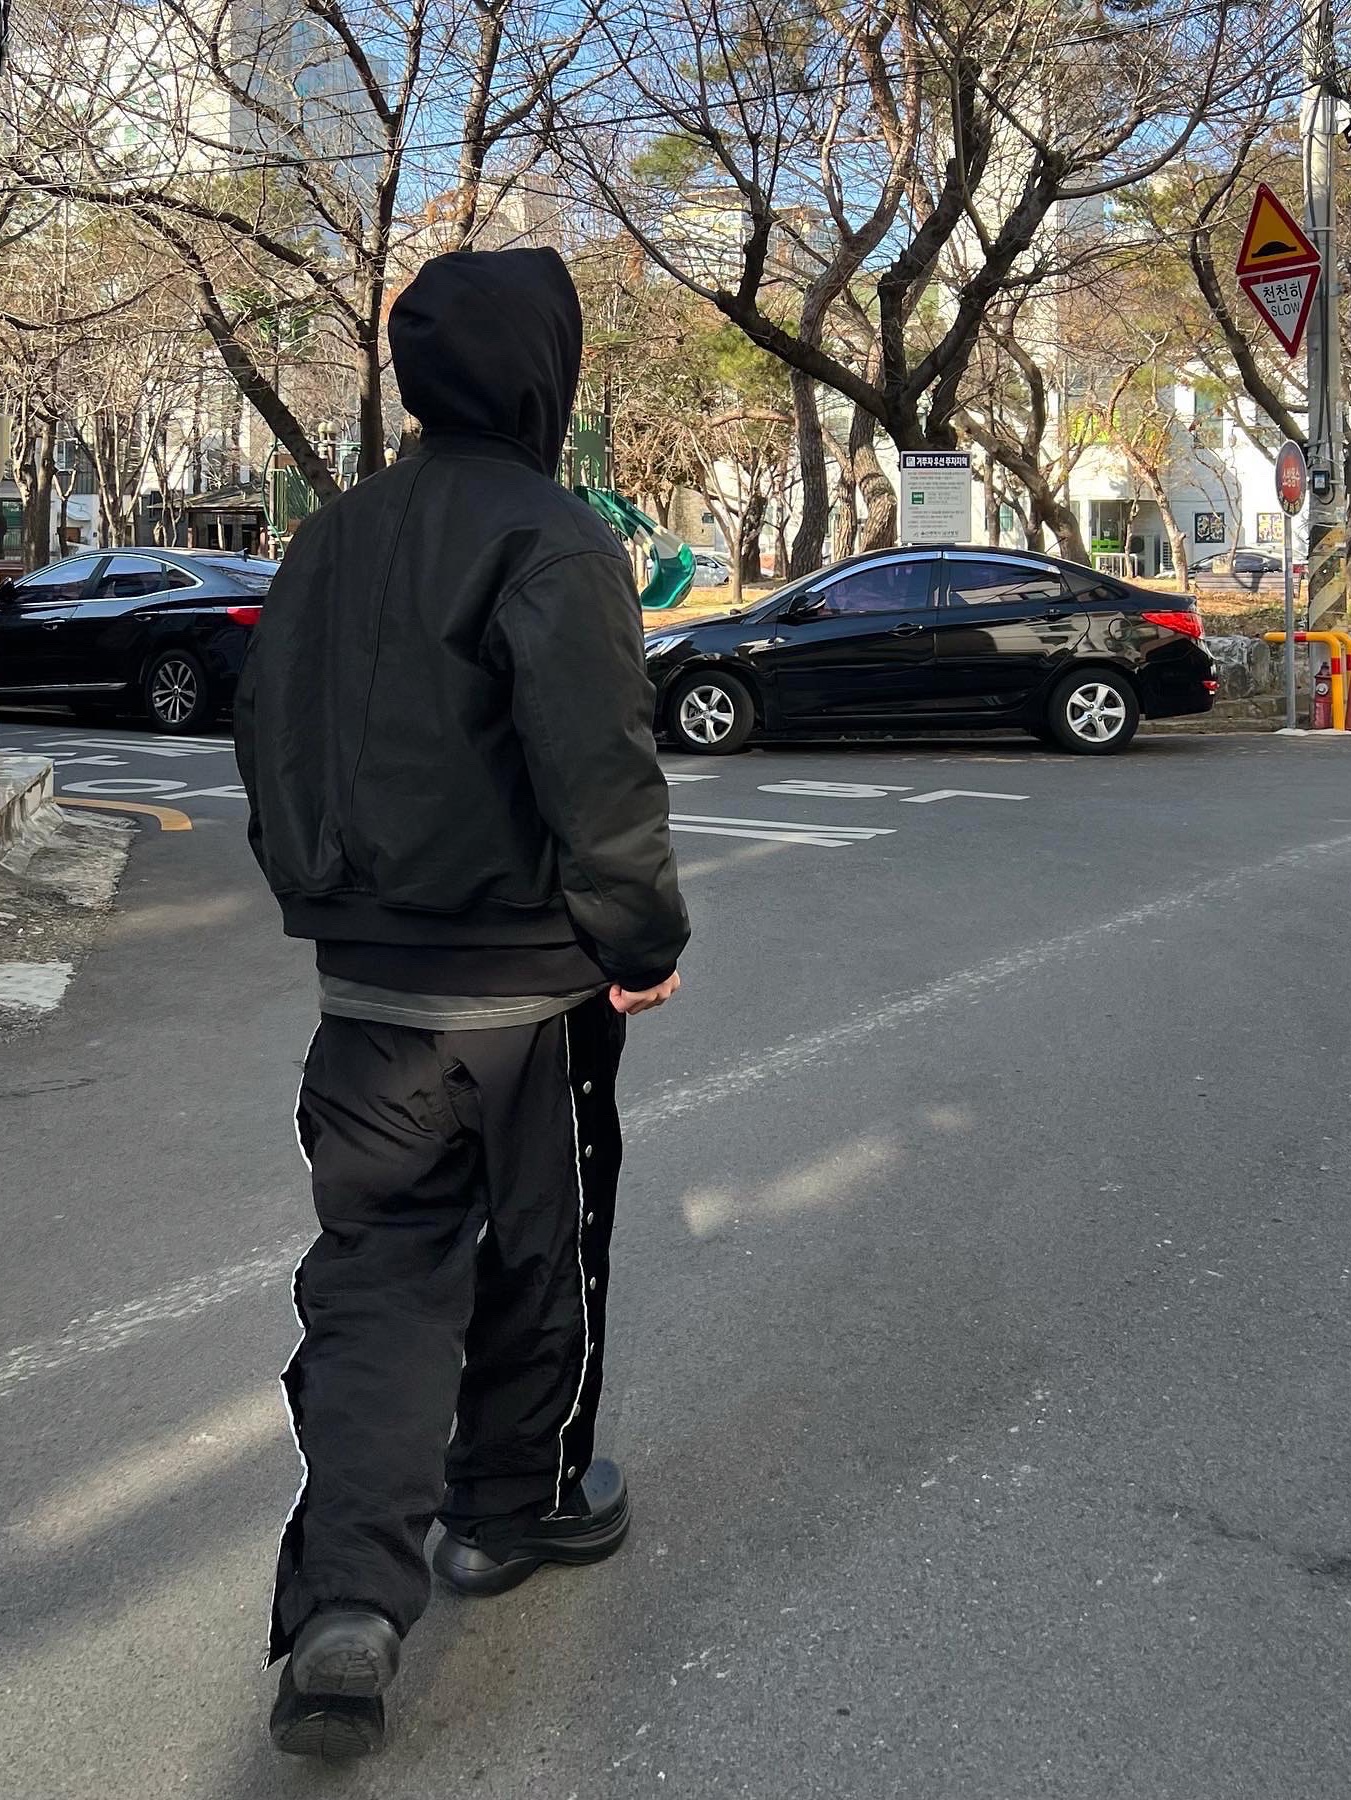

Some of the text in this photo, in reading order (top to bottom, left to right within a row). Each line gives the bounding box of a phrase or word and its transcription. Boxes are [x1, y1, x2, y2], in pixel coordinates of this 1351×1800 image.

[1263, 283, 1303, 303] 천천히
[1271, 303, 1300, 317] SLOW
[916, 456, 967, 467] 거주자 우선 주차지역
